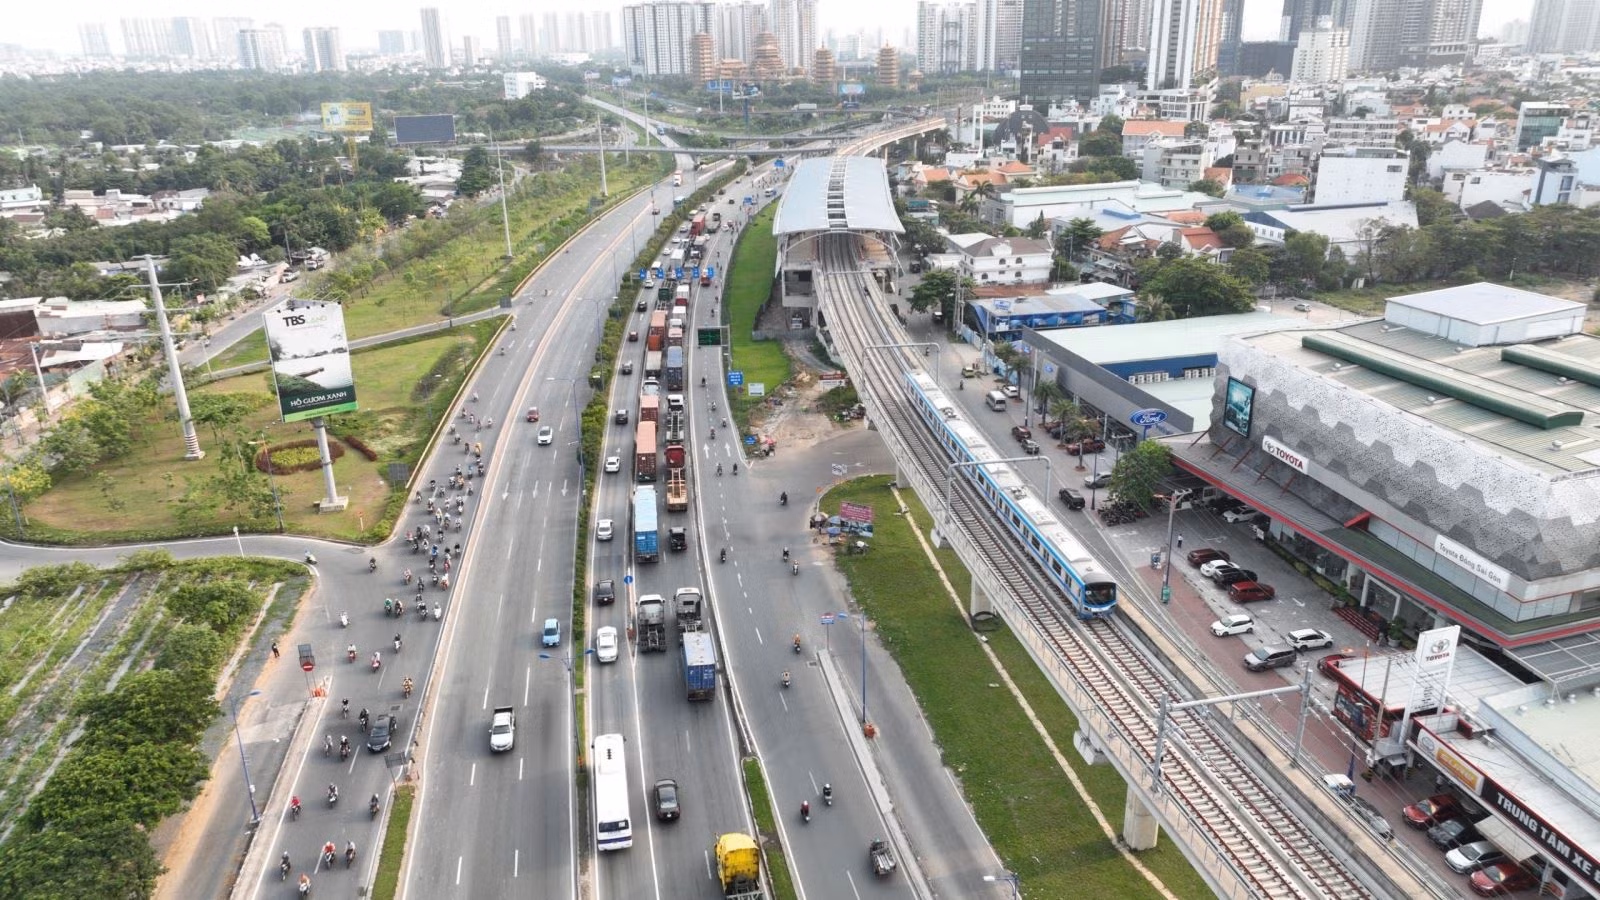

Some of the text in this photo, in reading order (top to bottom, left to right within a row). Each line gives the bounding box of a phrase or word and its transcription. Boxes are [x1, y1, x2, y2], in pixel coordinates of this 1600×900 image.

[282, 315, 306, 327] TBS
[326, 391, 347, 399] XANH
[1275, 447, 1304, 470] TOYOTA
[1439, 542, 1458, 559] Toyota
[1425, 652, 1450, 662] TOYOTA
[1497, 792, 1593, 876] TRUNG TÂM XE
